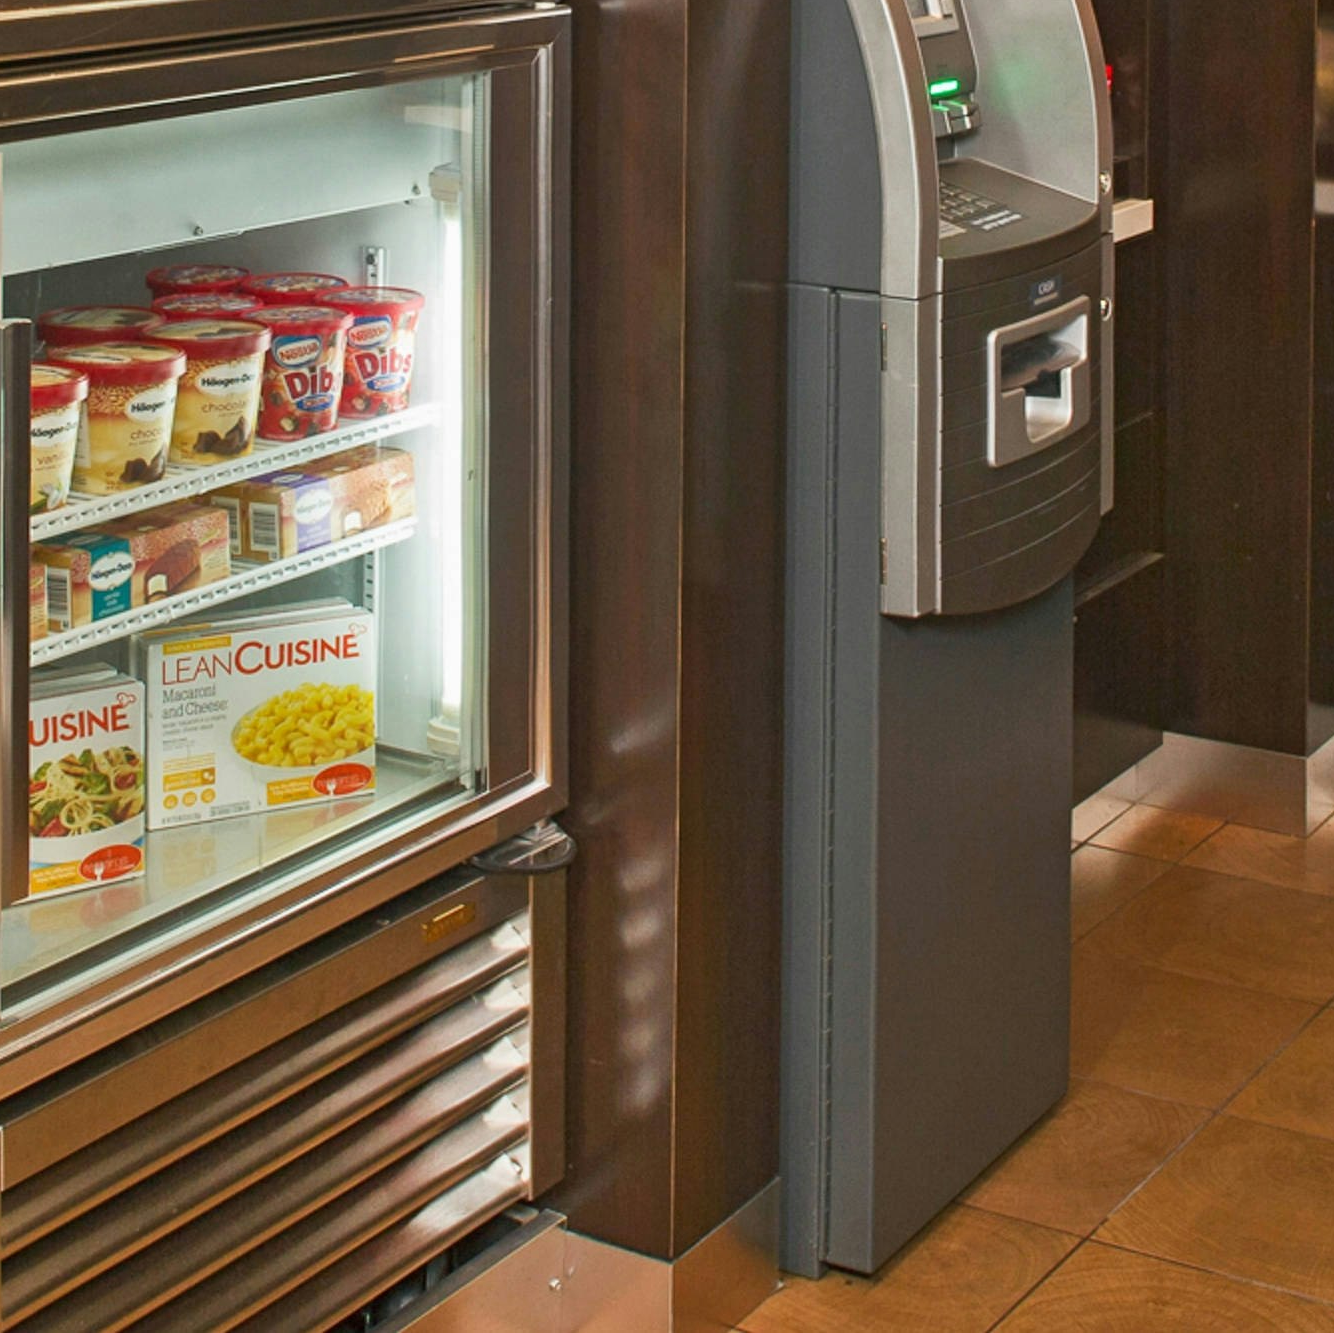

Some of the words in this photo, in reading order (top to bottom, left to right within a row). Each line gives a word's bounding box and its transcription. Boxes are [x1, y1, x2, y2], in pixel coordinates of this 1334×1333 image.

[354, 346, 412, 381] Dibs
[283, 367, 334, 401] Dib
[162, 651, 233, 686] LEAN
[234, 633, 360, 675] CUISINE
[162, 684, 216, 705] Macaroni
[162, 703, 185, 719] and
[185, 699, 229, 717] Cheese
[29, 703, 130, 747] UISINE
